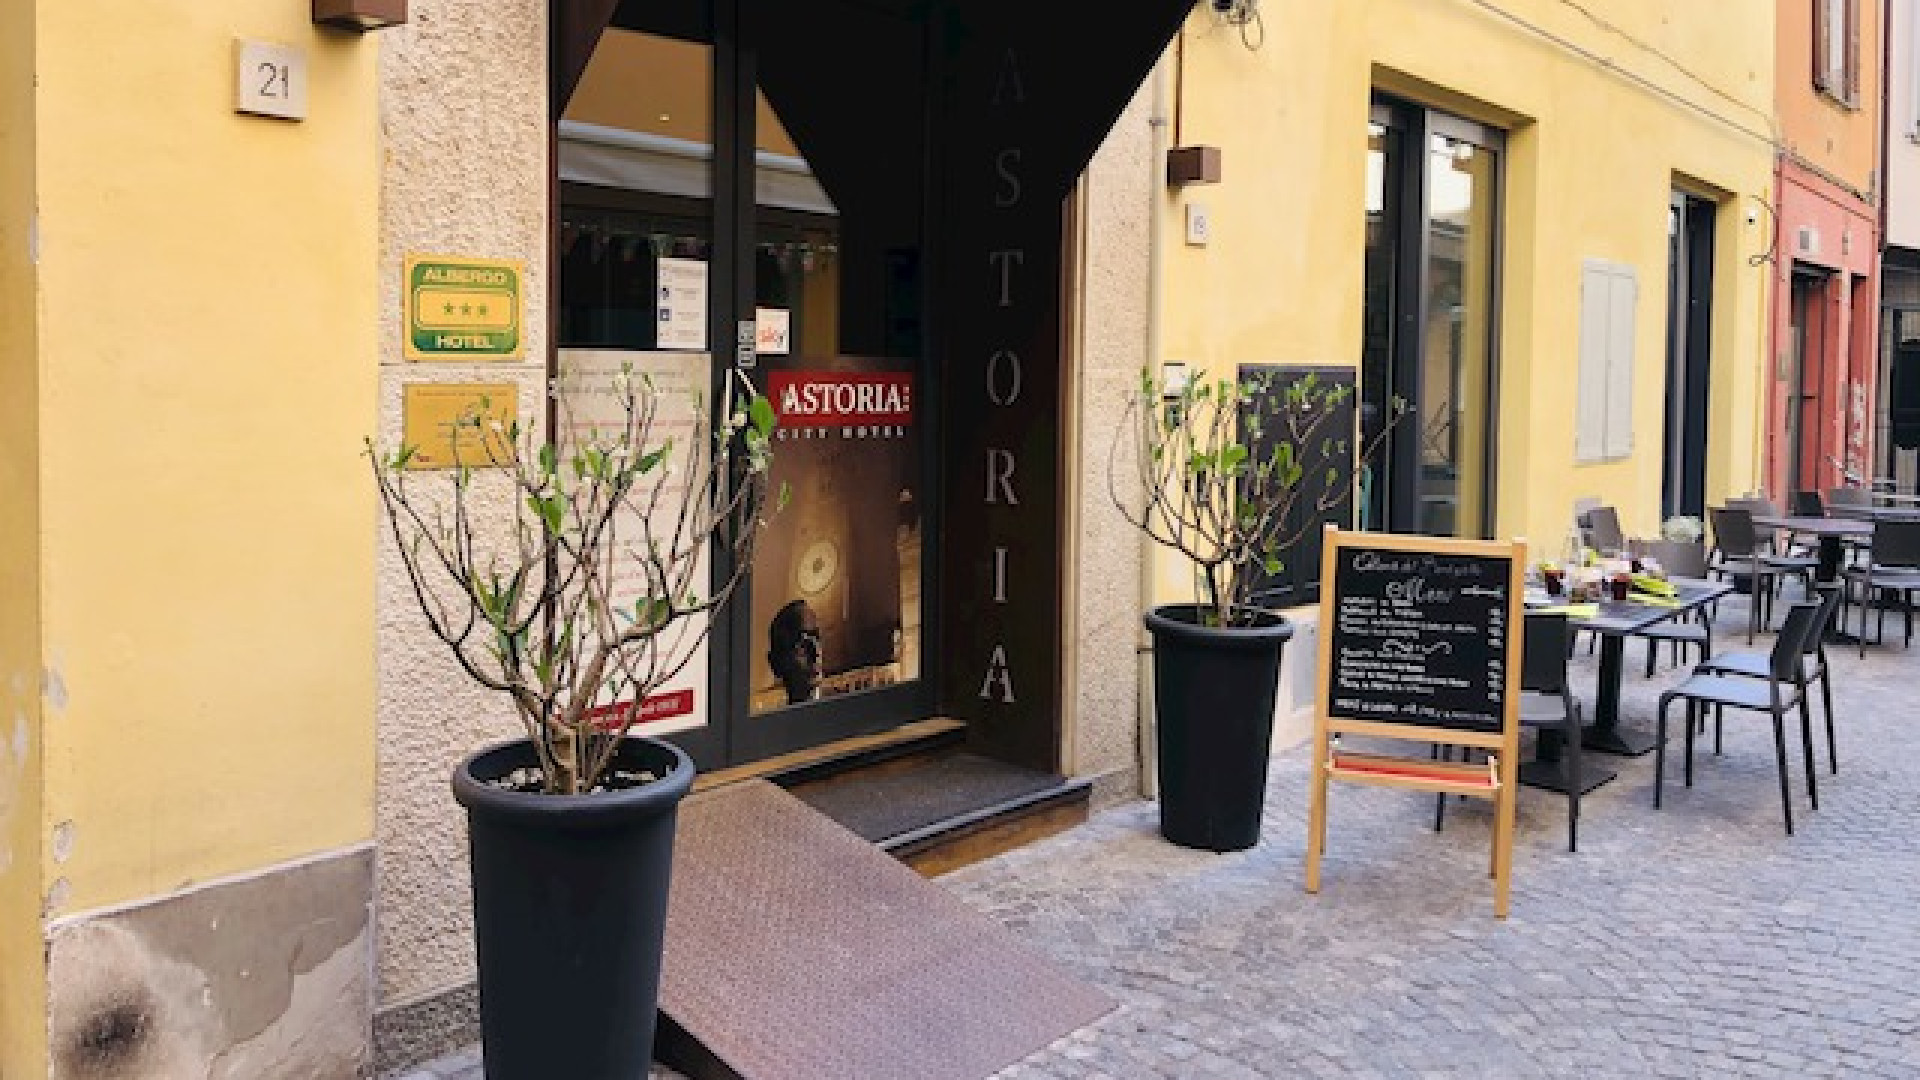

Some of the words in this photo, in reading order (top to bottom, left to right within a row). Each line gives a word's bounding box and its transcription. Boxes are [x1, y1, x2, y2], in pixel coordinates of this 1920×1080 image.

[256, 61, 291, 99] 21
[422, 266, 507, 286] ALBERGO
[434, 335, 496, 349] HOTEL
[979, 46, 1027, 703] ASTORIA
[782, 382, 902, 415] ASTORIA
[776, 427, 827, 441] CITY
[841, 425, 905, 440] HOTEL
